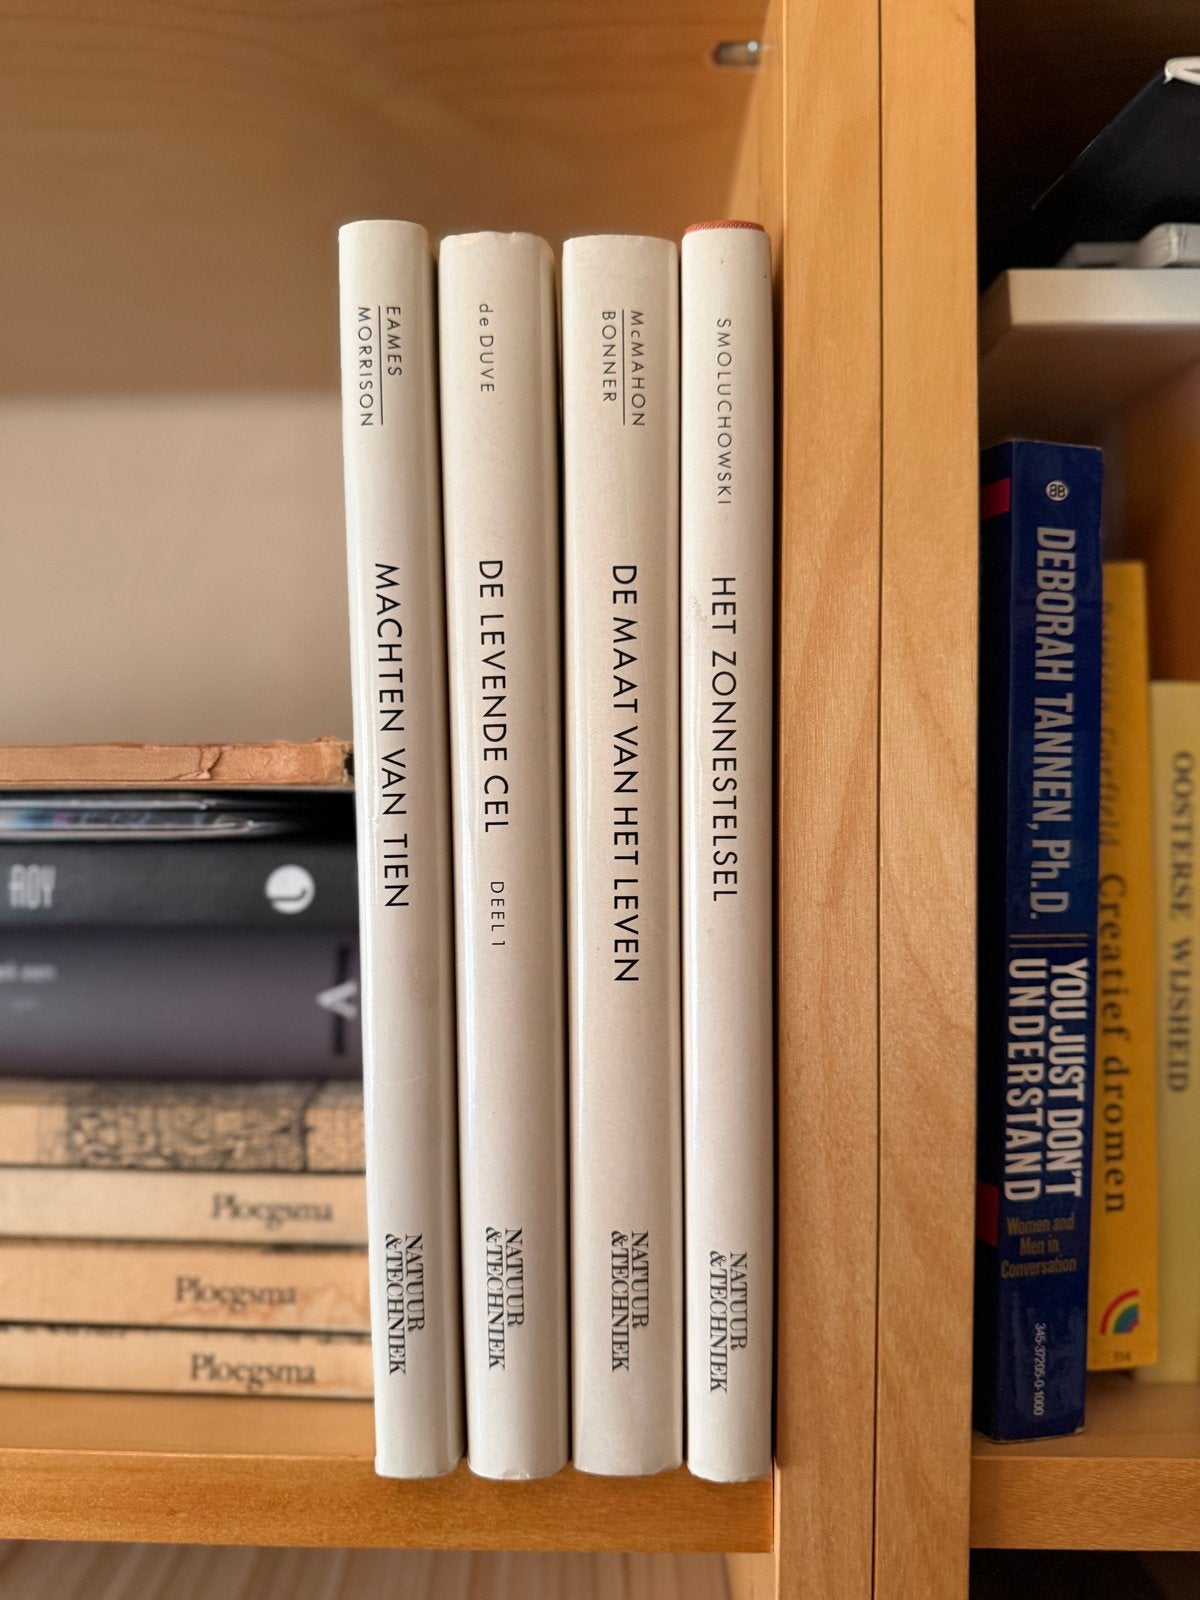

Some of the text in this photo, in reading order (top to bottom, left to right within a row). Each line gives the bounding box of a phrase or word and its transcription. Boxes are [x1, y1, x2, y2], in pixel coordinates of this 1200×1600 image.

[357, 306, 374, 427] MORRISON
[386, 306, 403, 376] EAMES
[478, 303, 495, 393] de DUVE
[601, 310, 617, 402] BONNER
[630, 309, 646, 426] McMAHON
[716, 318, 732, 504] SMOLUCHOWSKI
[374, 563, 410, 907] MACHTEN VAN TIEN
[478, 560, 509, 833] DE LEVENDE CEL
[711, 577, 738, 902] HET ZONNESTELSEL
[1026, 526, 1077, 920] DEBORAH TANNEN, Ph.D.
[612, 565, 639, 982] DE MAAT VAN HET LEVEN
[490, 881, 505, 933] DEEL
[1166, 751, 1194, 1094] OOSTERSE WIJSHEID
[1004, 958, 1047, 1201] UNDERSTAND
[1045, 958, 1089, 1198] YOU JUST DON'T
[1099, 872, 1130, 1213] Creatief dromen
[211, 1193, 334, 1231] Ploegsma
[1006, 1211, 1076, 1236] Women and
[1020, 1234, 1060, 1256] Men in
[175, 1276, 297, 1314] Ploegsma
[404, 1232, 426, 1332] NATUUR
[504, 1227, 525, 1327] NATUUR
[631, 1230, 650, 1329] NATUUR
[729, 1251, 748, 1350] NATUUR
[1001, 1254, 1077, 1279] Conversation
[190, 1353, 316, 1391] Ploegsma
